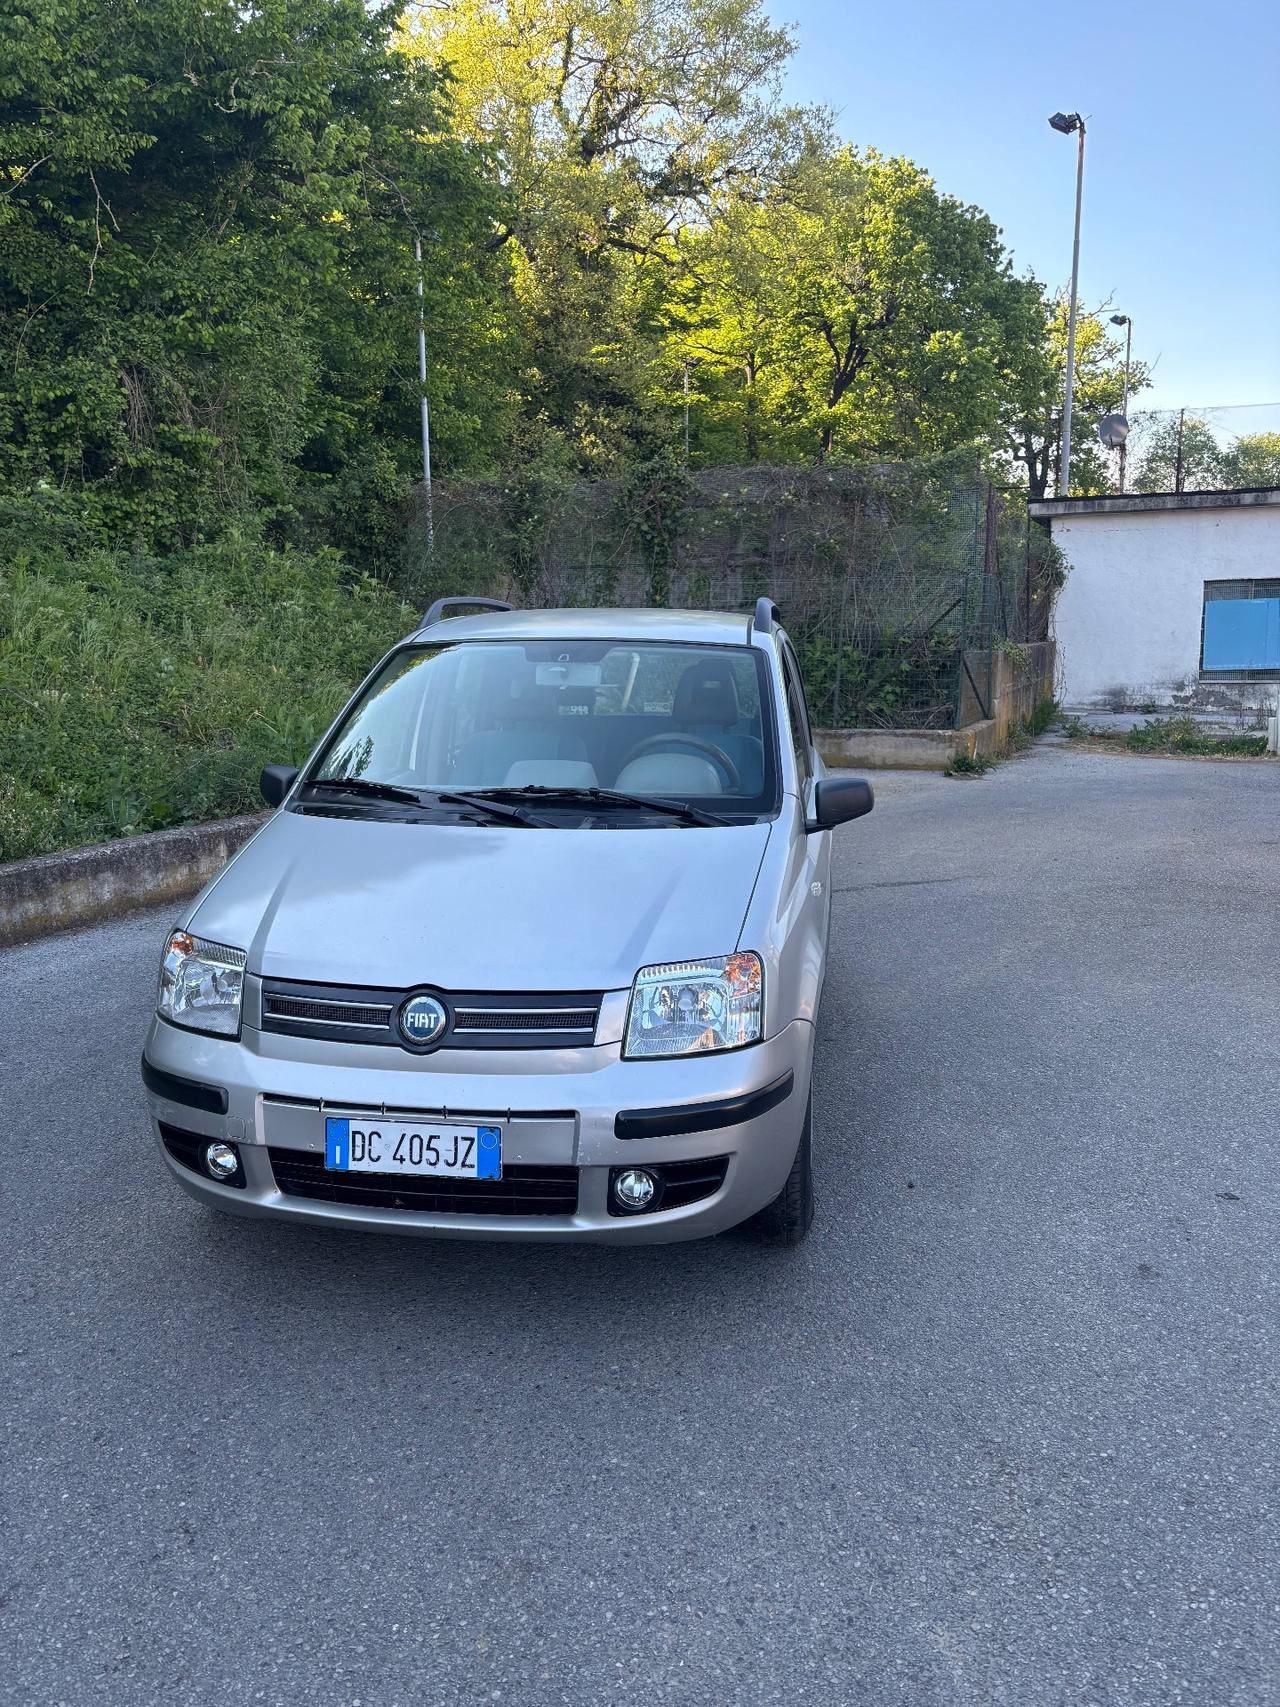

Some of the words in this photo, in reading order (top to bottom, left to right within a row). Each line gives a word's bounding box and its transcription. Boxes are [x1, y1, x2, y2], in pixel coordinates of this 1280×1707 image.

[407, 1012, 437, 1028] FIAT
[335, 1145, 341, 1164] I
[351, 1130, 382, 1162] DC
[392, 1133, 475, 1168] 405JZ
